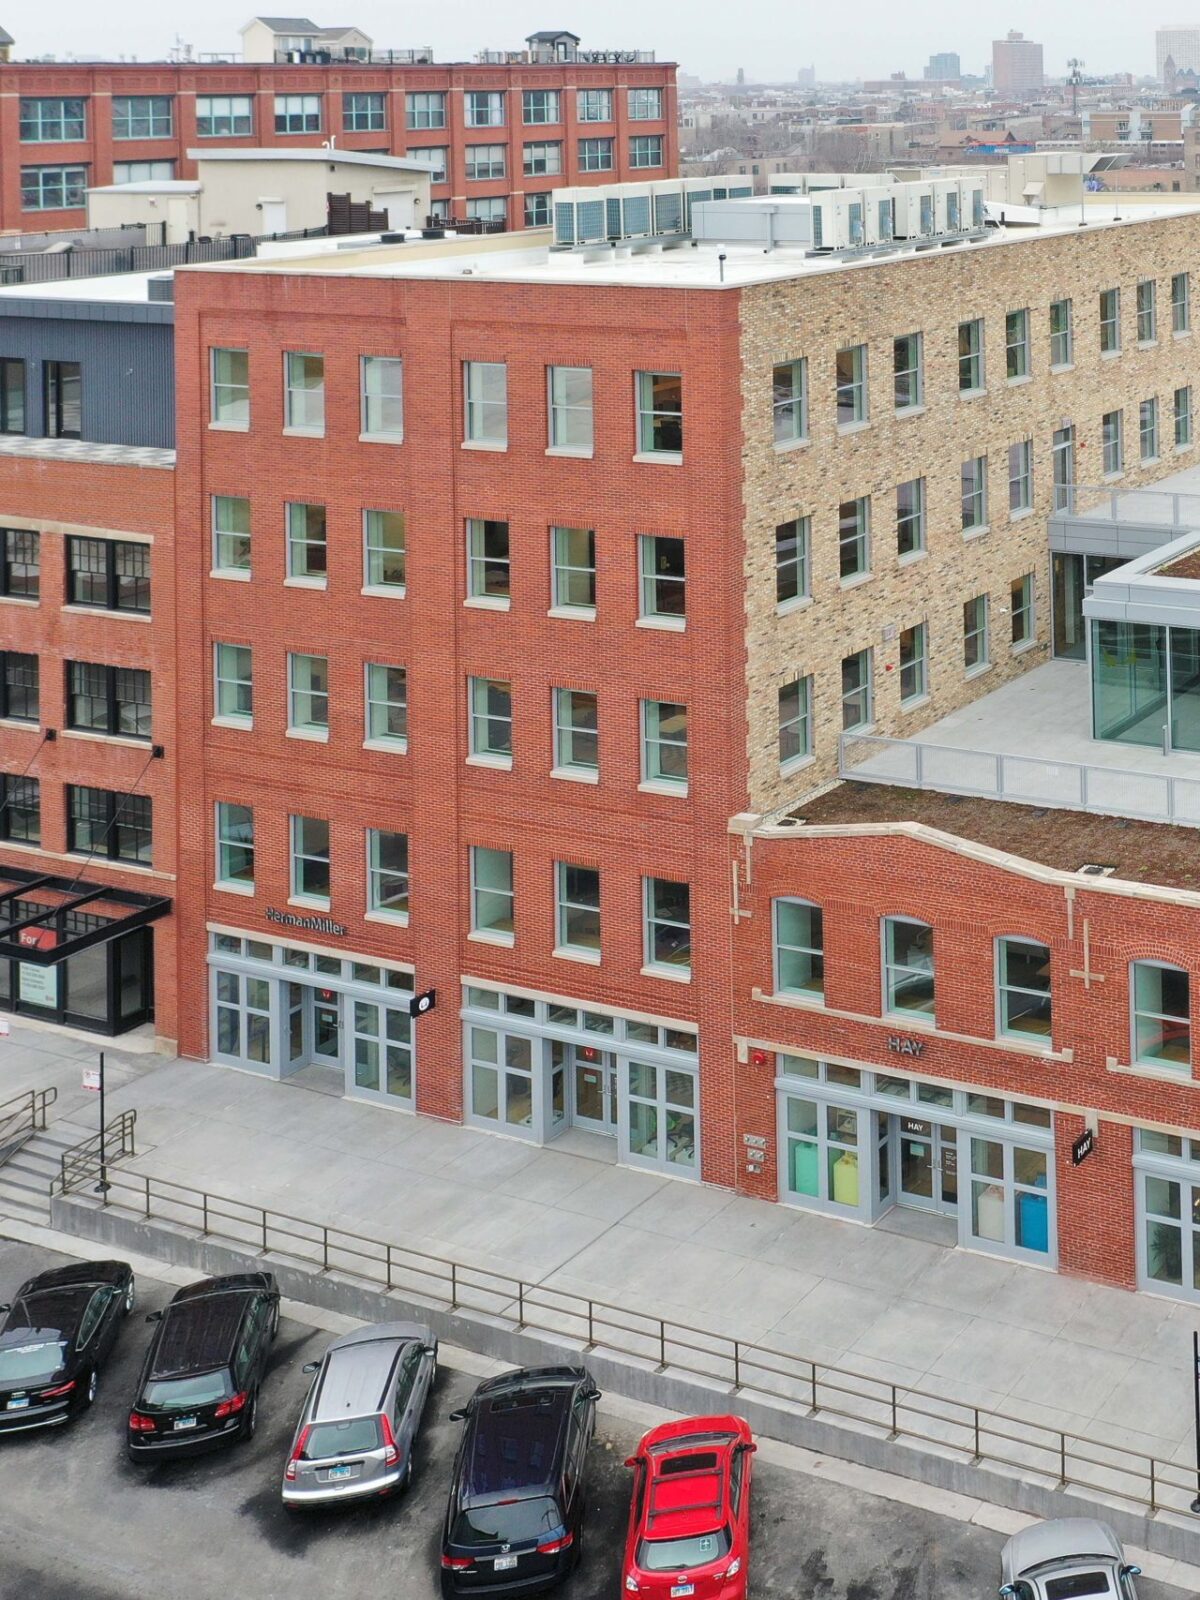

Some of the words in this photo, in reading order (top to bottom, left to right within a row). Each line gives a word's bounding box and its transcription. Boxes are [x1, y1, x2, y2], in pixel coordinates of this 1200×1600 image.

[265, 907, 346, 936] HermanMiller
[888, 1036, 923, 1056] HAY
[907, 1121, 924, 1131] HAY
[1077, 1137, 1091, 1159] HAY
